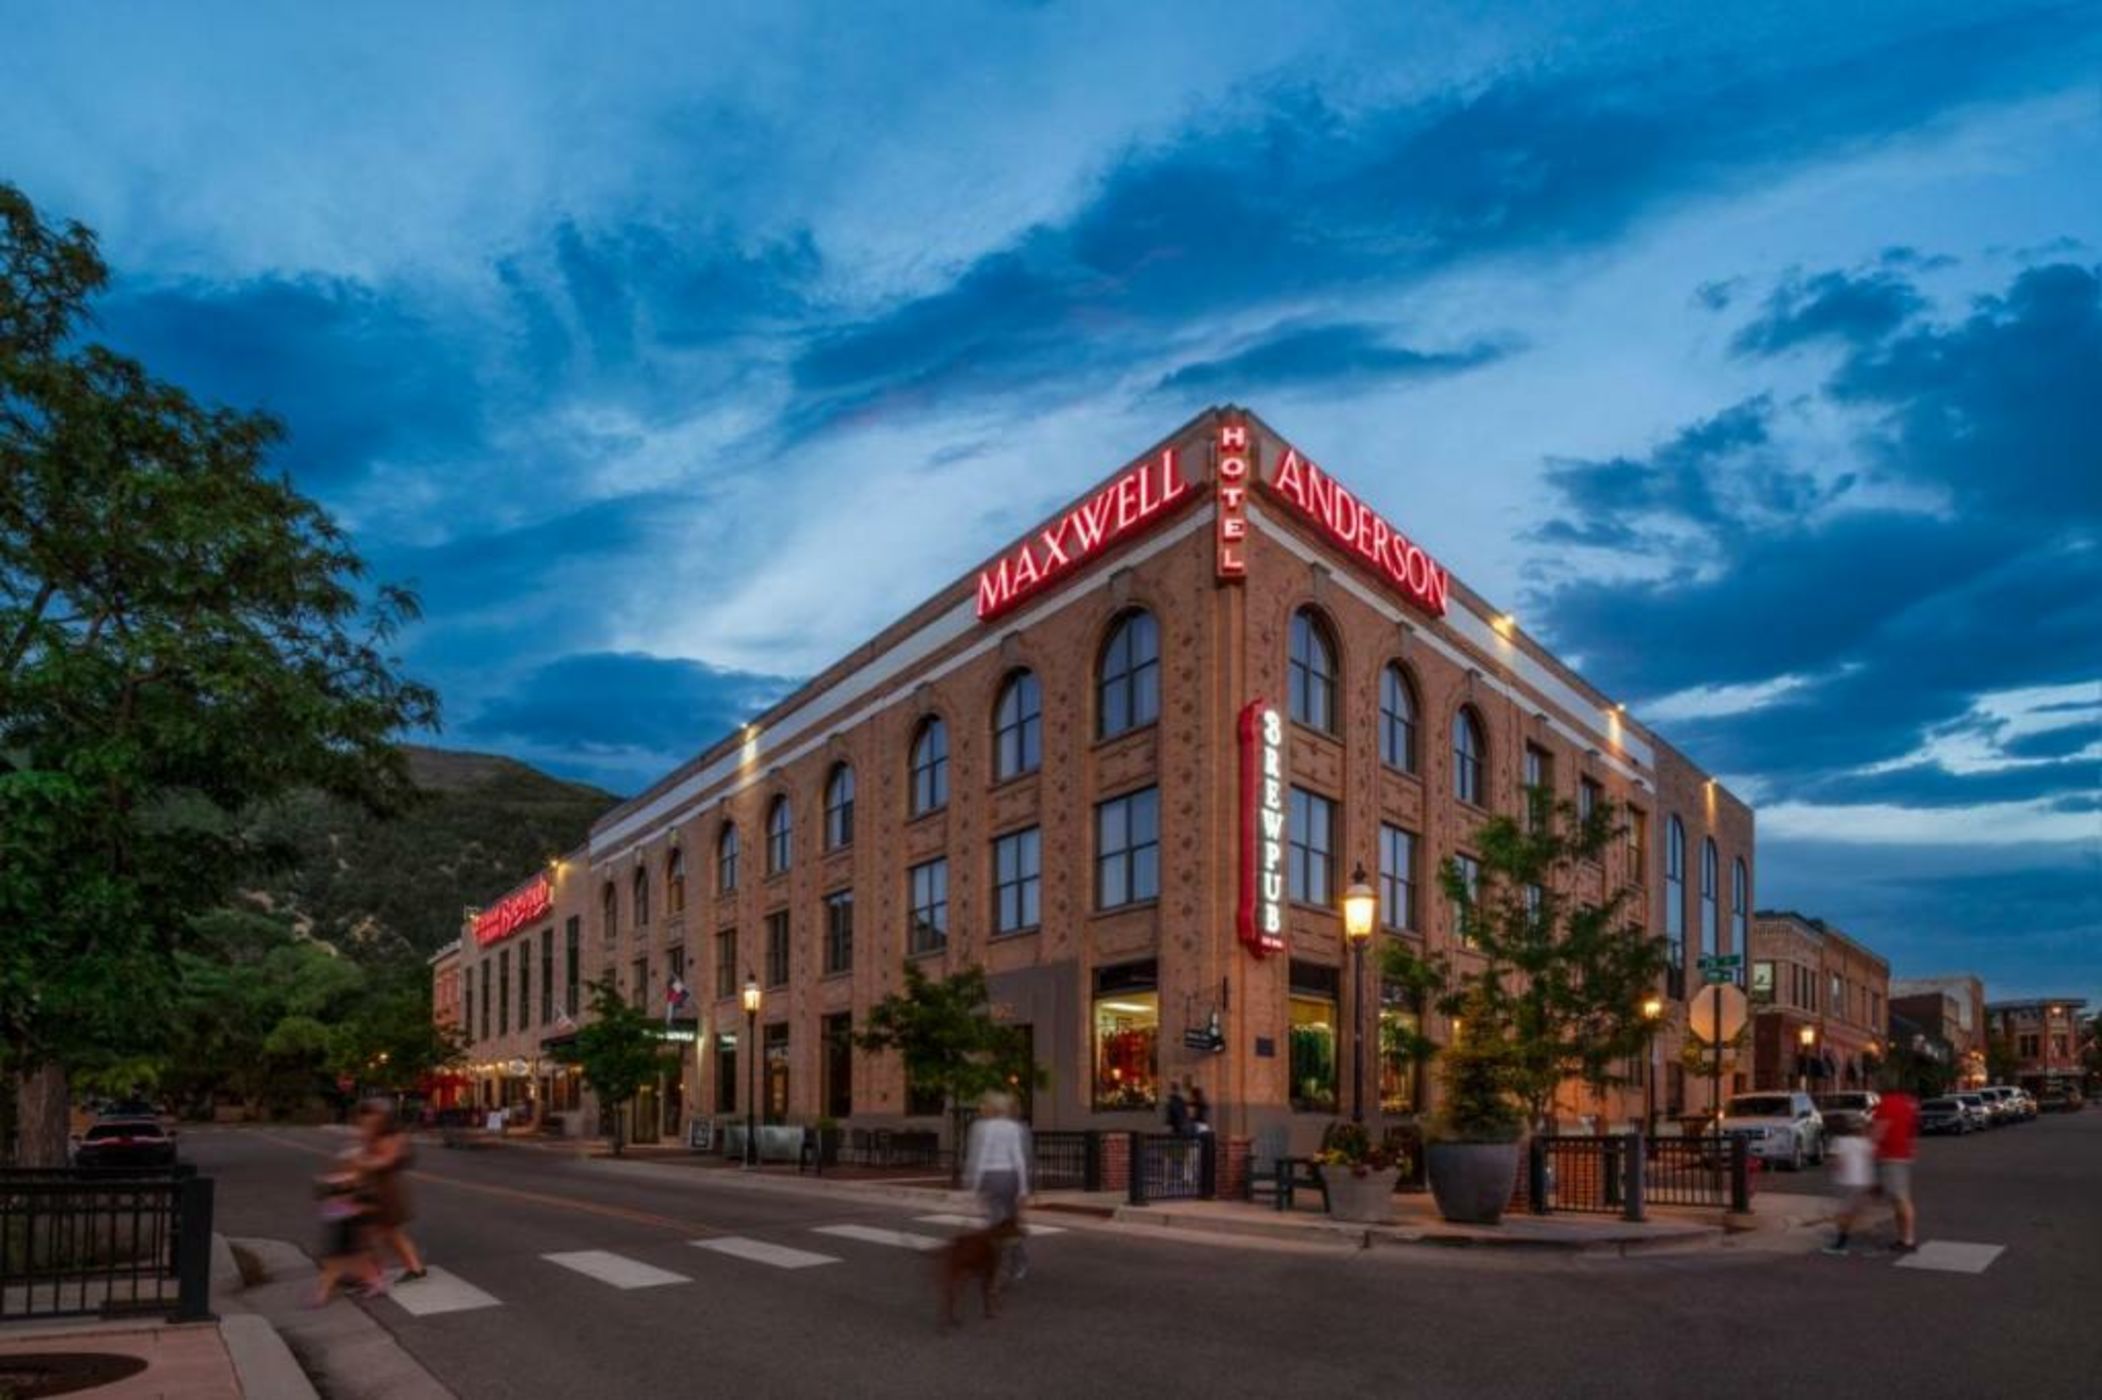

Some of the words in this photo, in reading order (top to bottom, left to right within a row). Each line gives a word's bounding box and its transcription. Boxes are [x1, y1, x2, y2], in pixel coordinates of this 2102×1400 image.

[977, 449, 1185, 616] MAXWELL
[1221, 426, 1246, 568] HOTEL
[1276, 449, 1448, 612] ANDERSON
